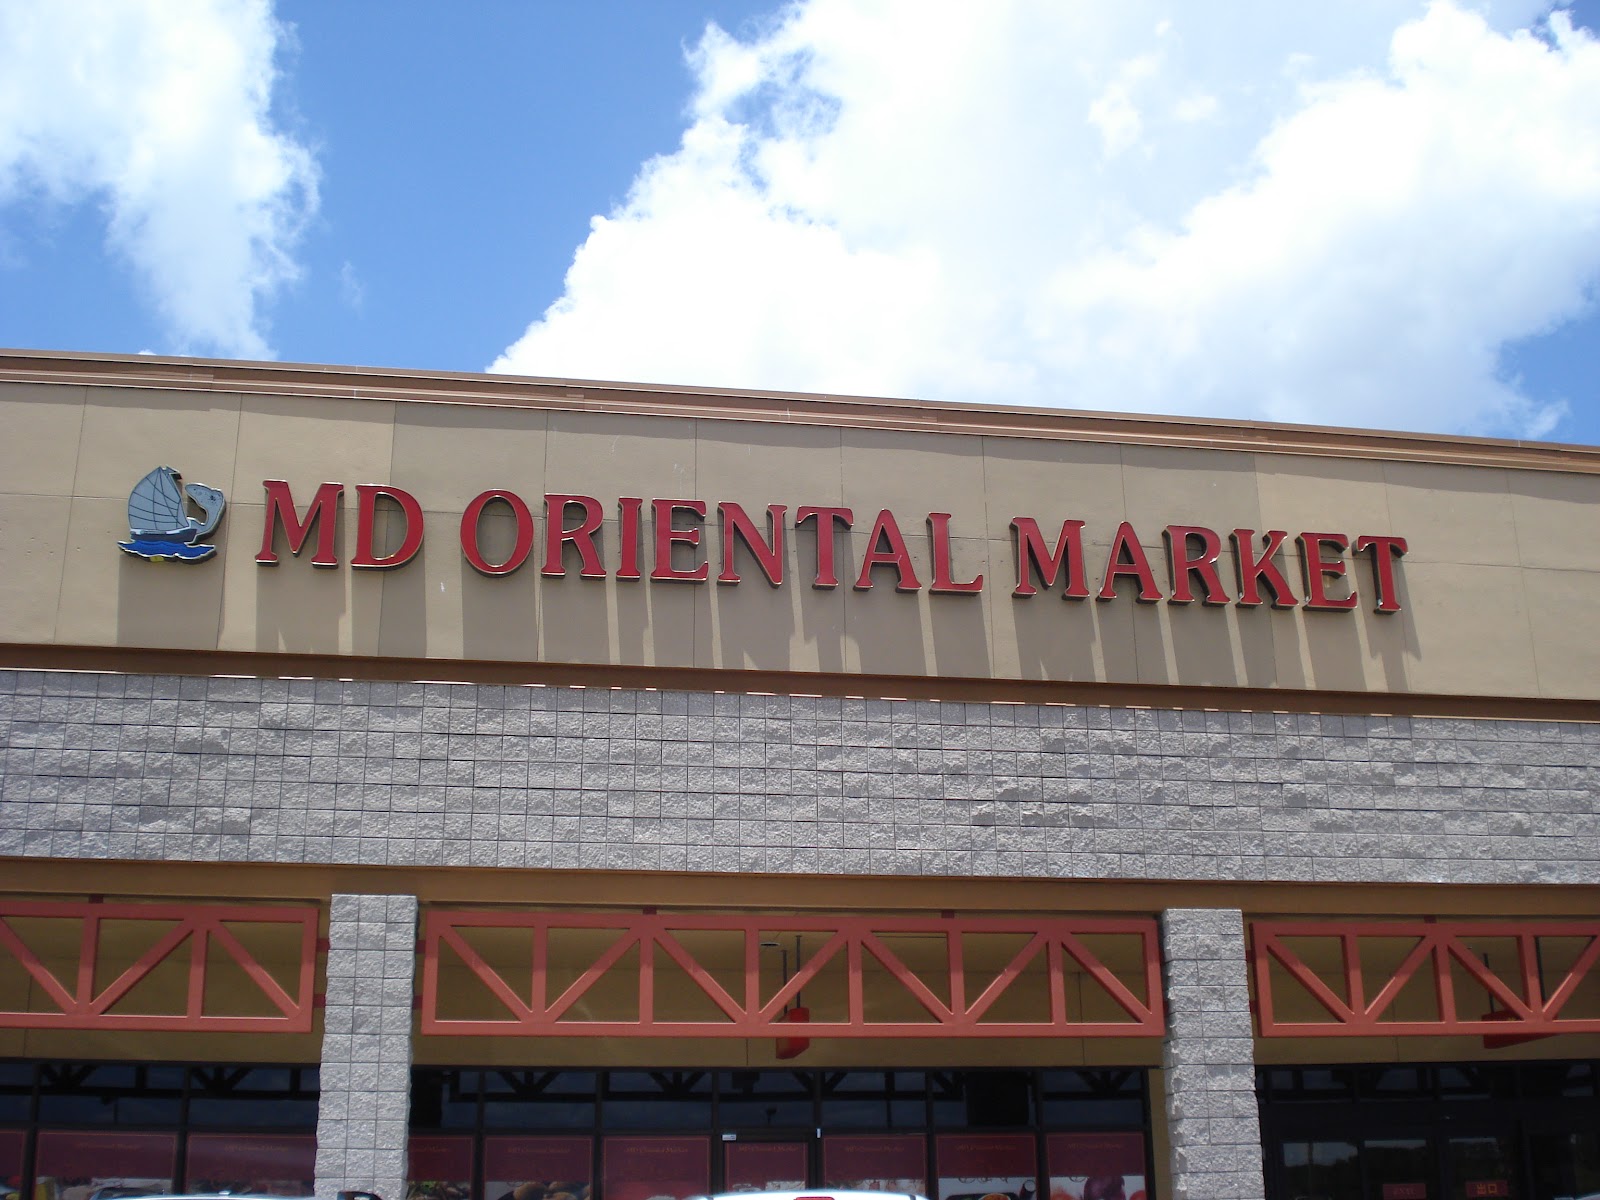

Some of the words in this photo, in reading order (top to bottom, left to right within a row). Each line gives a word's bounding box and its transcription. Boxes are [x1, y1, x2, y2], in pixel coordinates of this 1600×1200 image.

[255, 478, 424, 570] MD
[460, 487, 984, 594] ORIENTAL
[1010, 515, 1409, 615] MARKET
[1476, 1183, 1498, 1195] 出口
